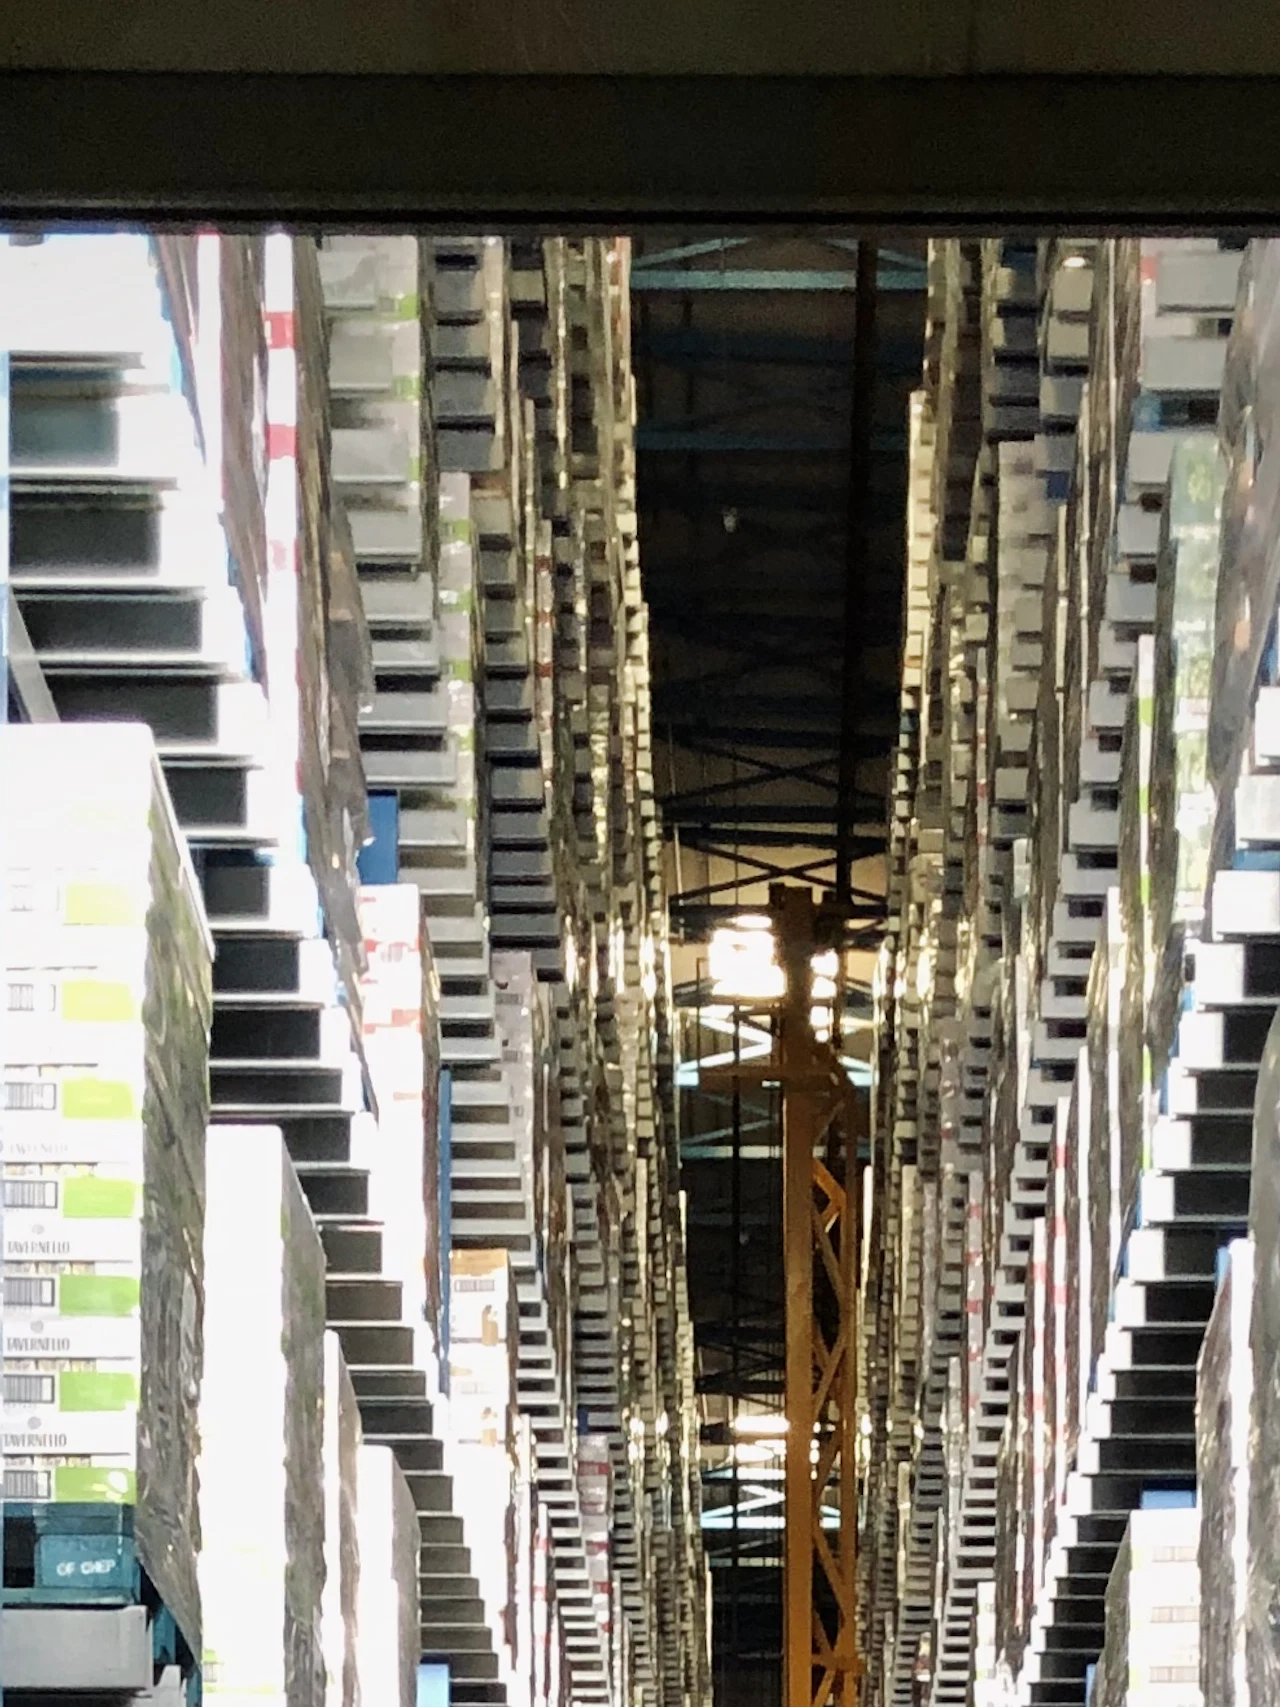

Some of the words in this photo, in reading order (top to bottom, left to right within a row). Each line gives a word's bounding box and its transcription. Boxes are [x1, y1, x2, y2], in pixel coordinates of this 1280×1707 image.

[7, 1240, 70, 1254] TAVERNELLO
[6, 1337, 70, 1351] TAVERNELLO
[3, 1433, 67, 1448] TAVERNELLO
